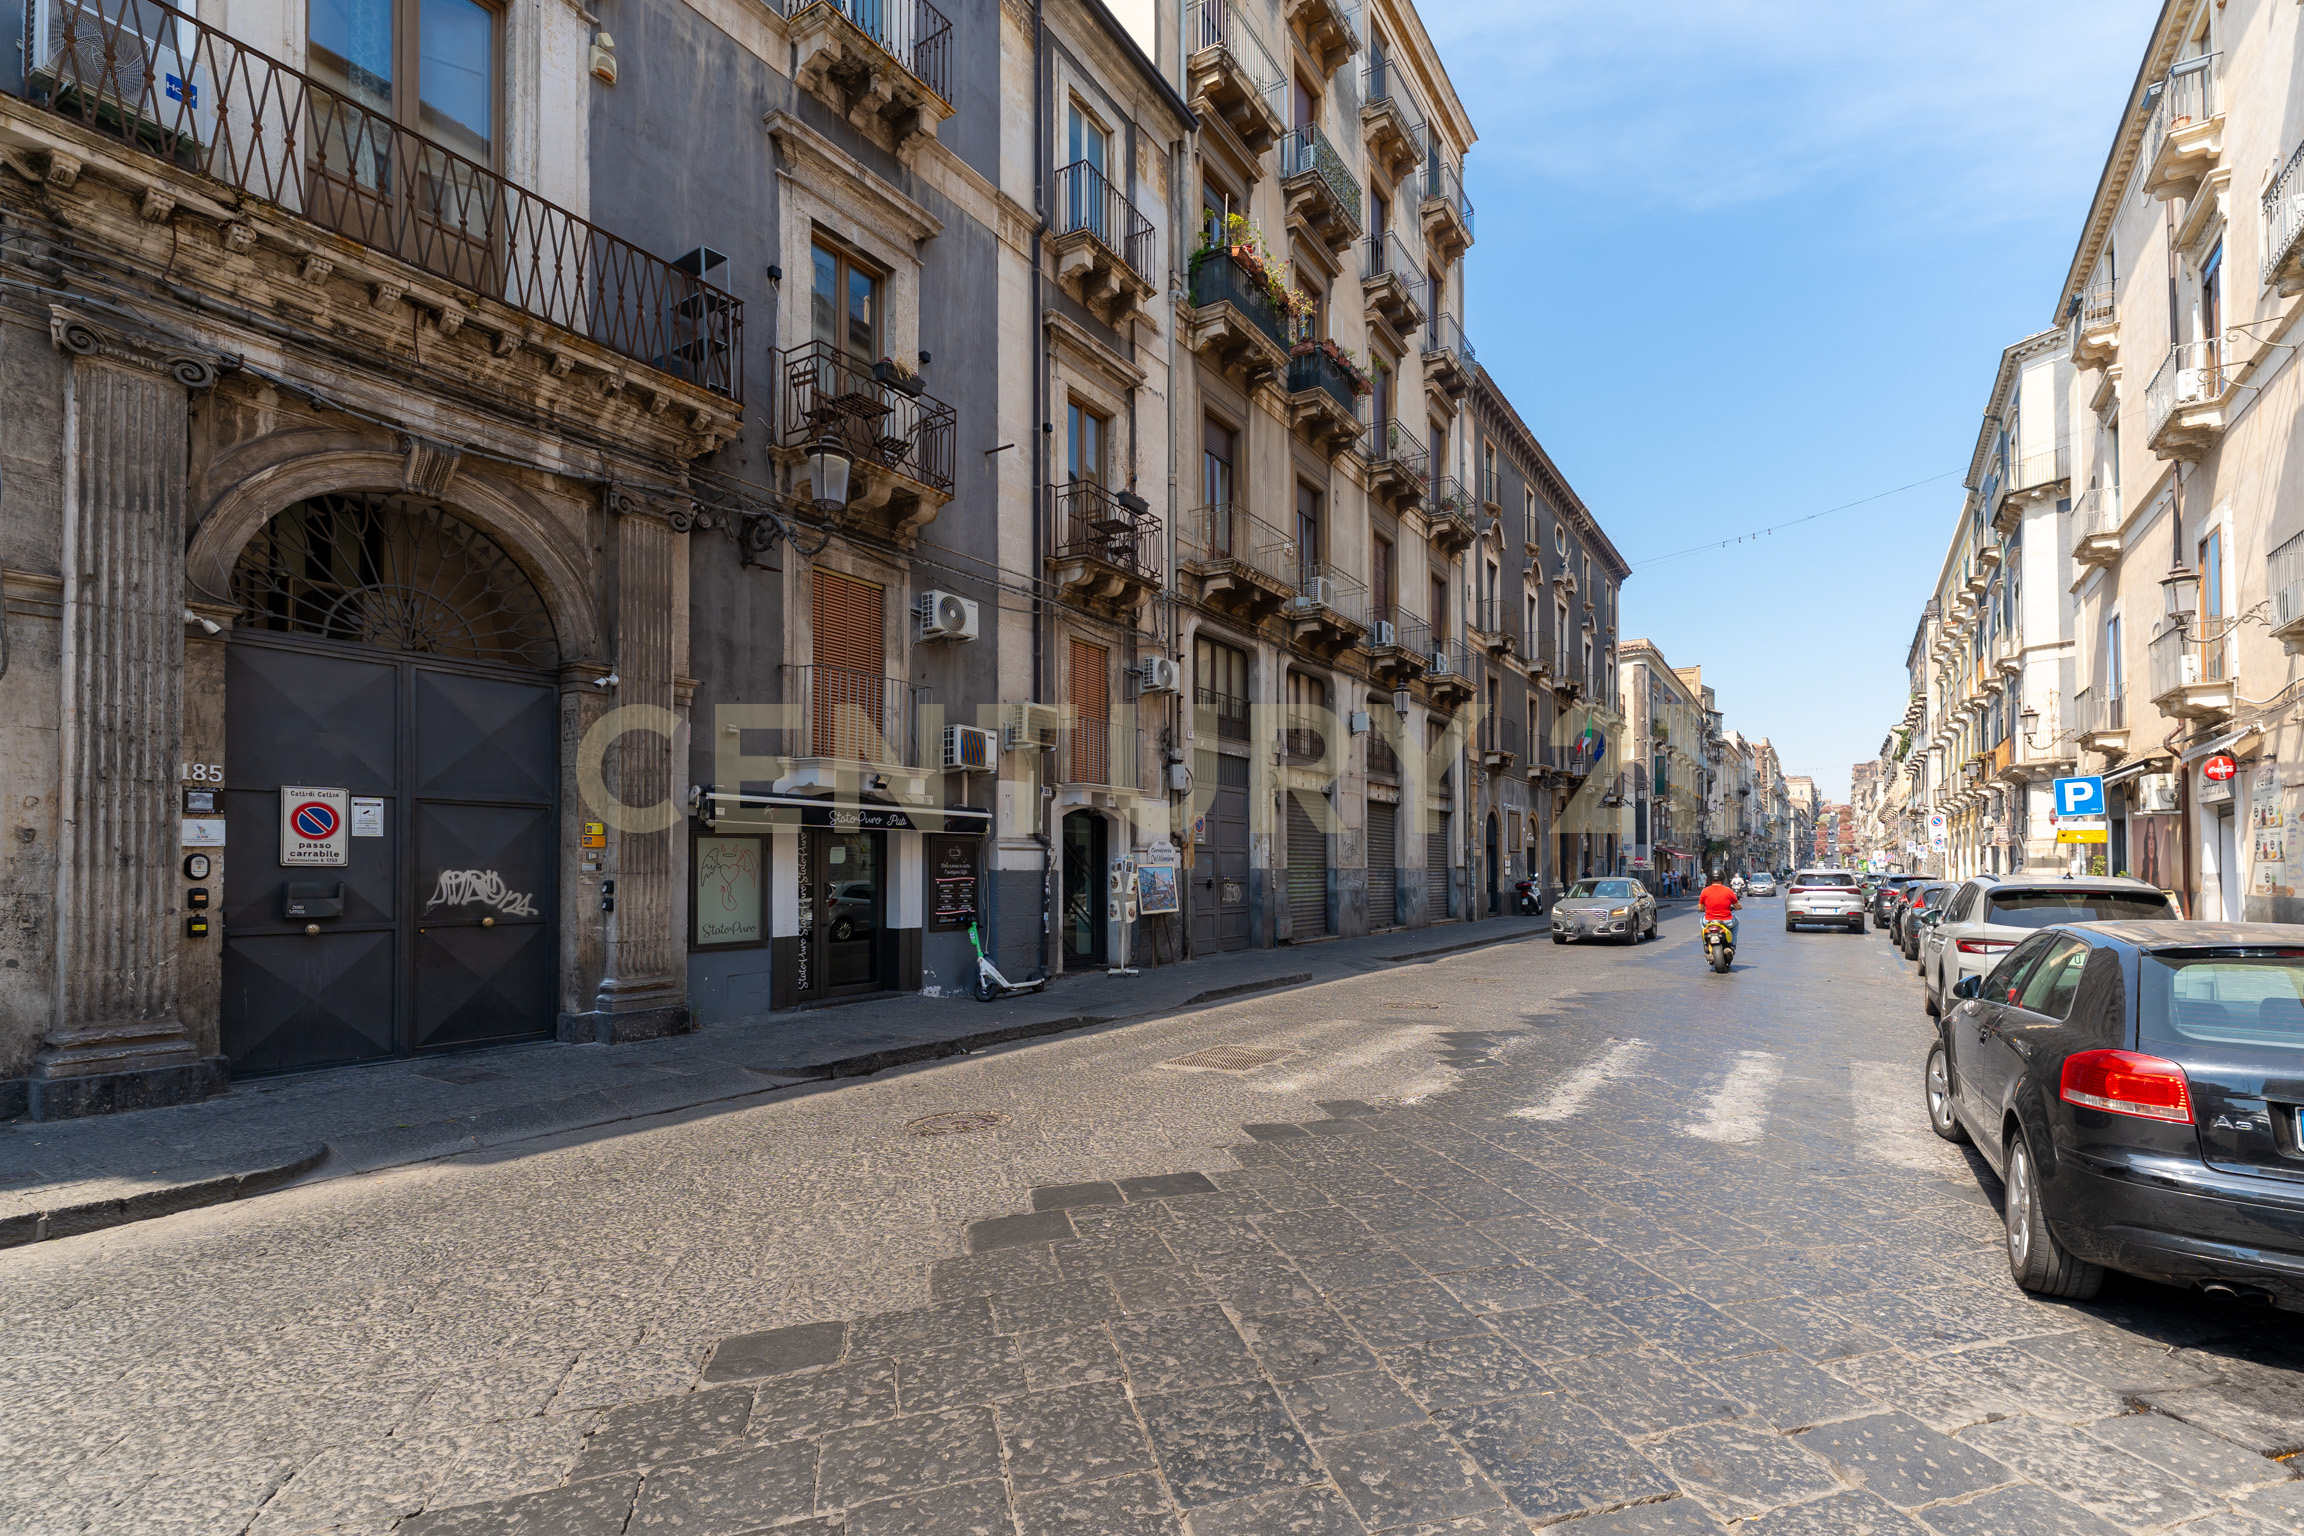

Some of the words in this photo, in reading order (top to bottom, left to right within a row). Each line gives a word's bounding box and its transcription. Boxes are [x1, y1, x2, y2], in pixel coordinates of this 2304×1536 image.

[182, 763, 223, 782] 185
[2064, 782, 2093, 812] P
[886, 814, 908, 826] Pub
[290, 850, 340, 858] carrabile
[2213, 1115, 2253, 1131] A3
